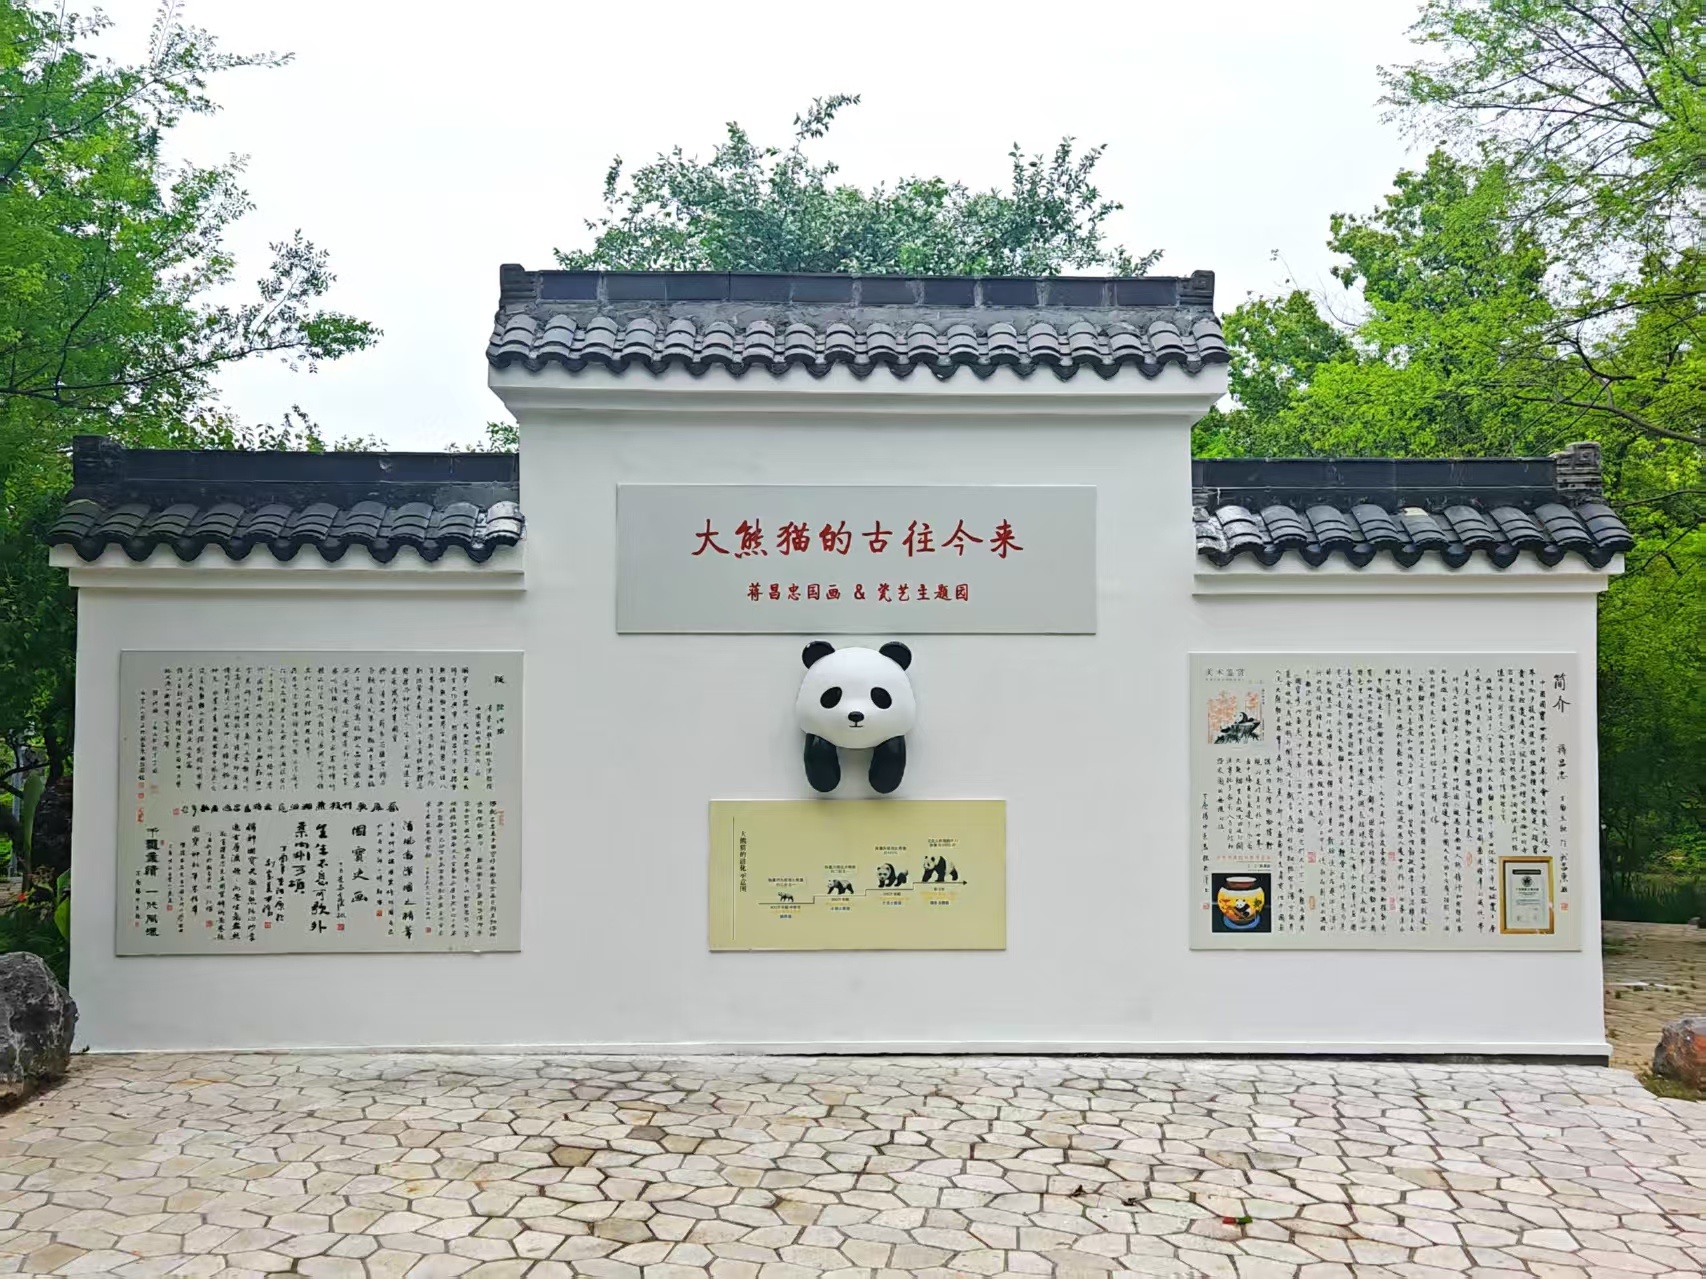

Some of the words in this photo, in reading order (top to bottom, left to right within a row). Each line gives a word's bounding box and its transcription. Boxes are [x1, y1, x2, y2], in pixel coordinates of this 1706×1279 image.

[692, 518, 1023, 559] 大熊猫的古往今来
[747, 583, 840, 601] 蒋昌忠国画
[854, 584, 865, 600] &
[877, 583, 969, 601] 瓷艺主题园
[1552, 672, 1571, 713] 简介
